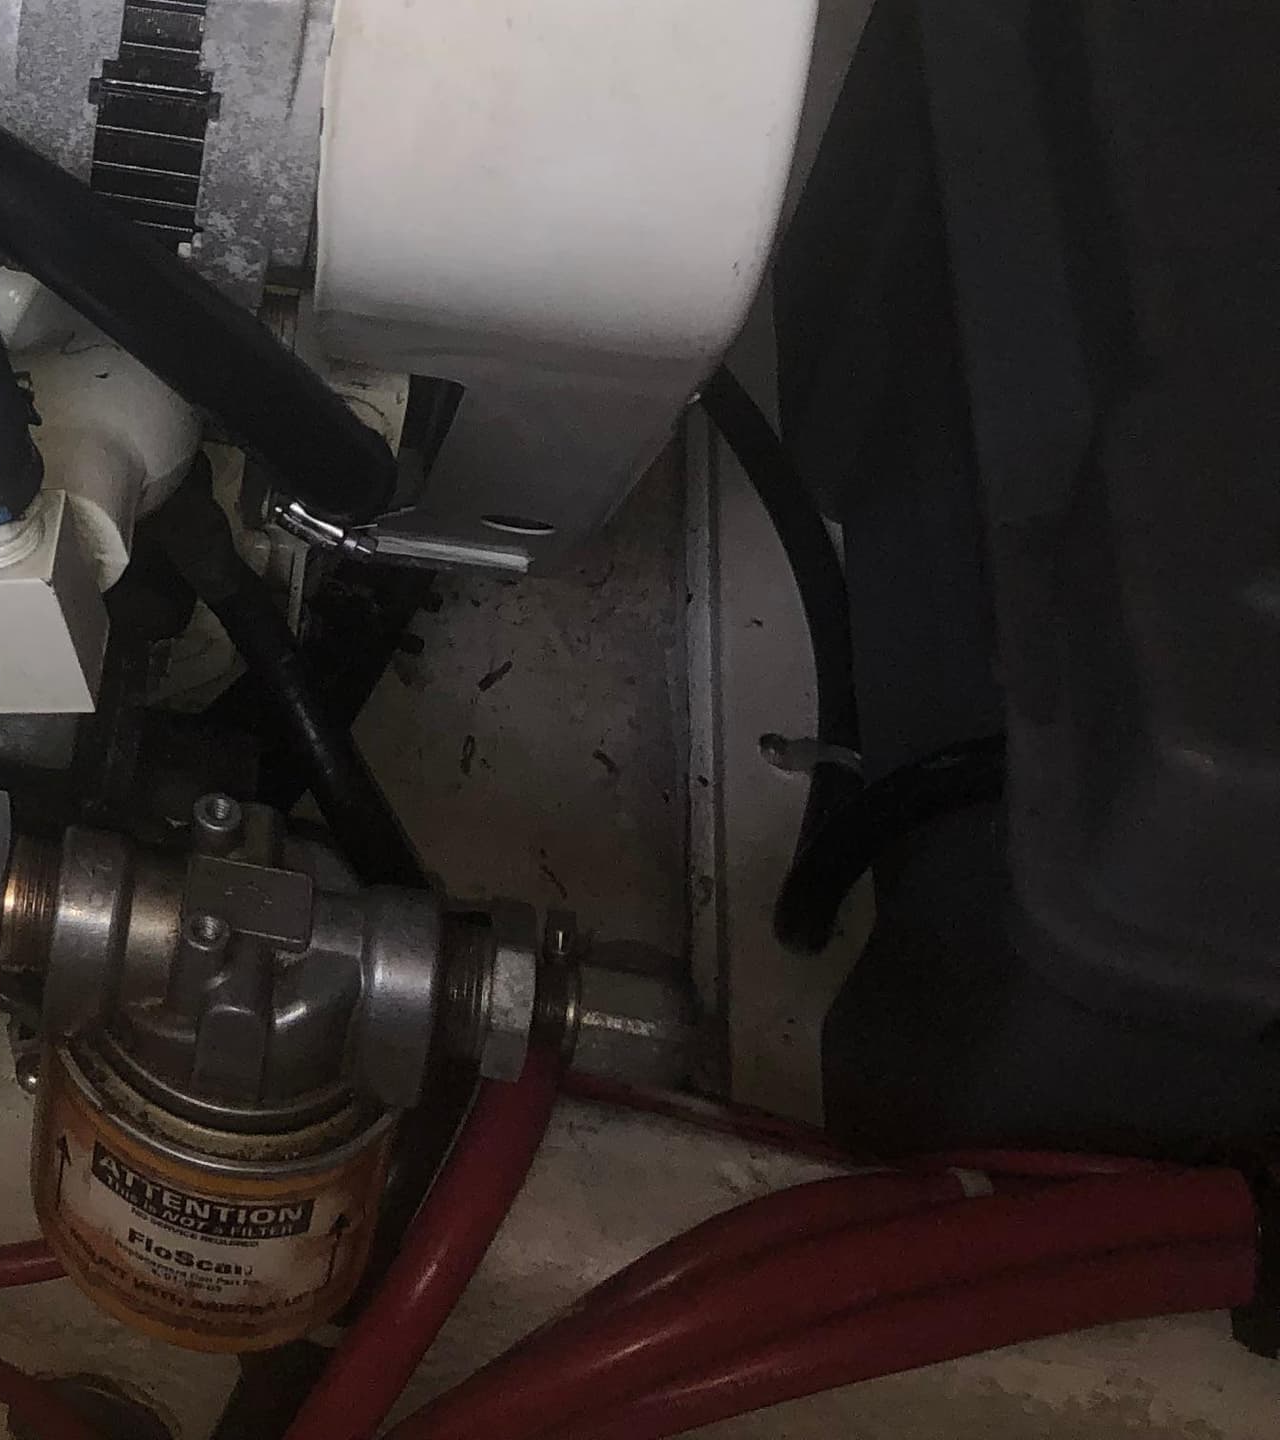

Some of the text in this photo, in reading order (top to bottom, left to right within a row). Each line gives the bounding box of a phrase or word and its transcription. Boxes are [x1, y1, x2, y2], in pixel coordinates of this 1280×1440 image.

[99, 1155, 303, 1224] ATTENTION
[162, 1209, 209, 1233] NOT
[128, 1227, 254, 1276] FloScan
